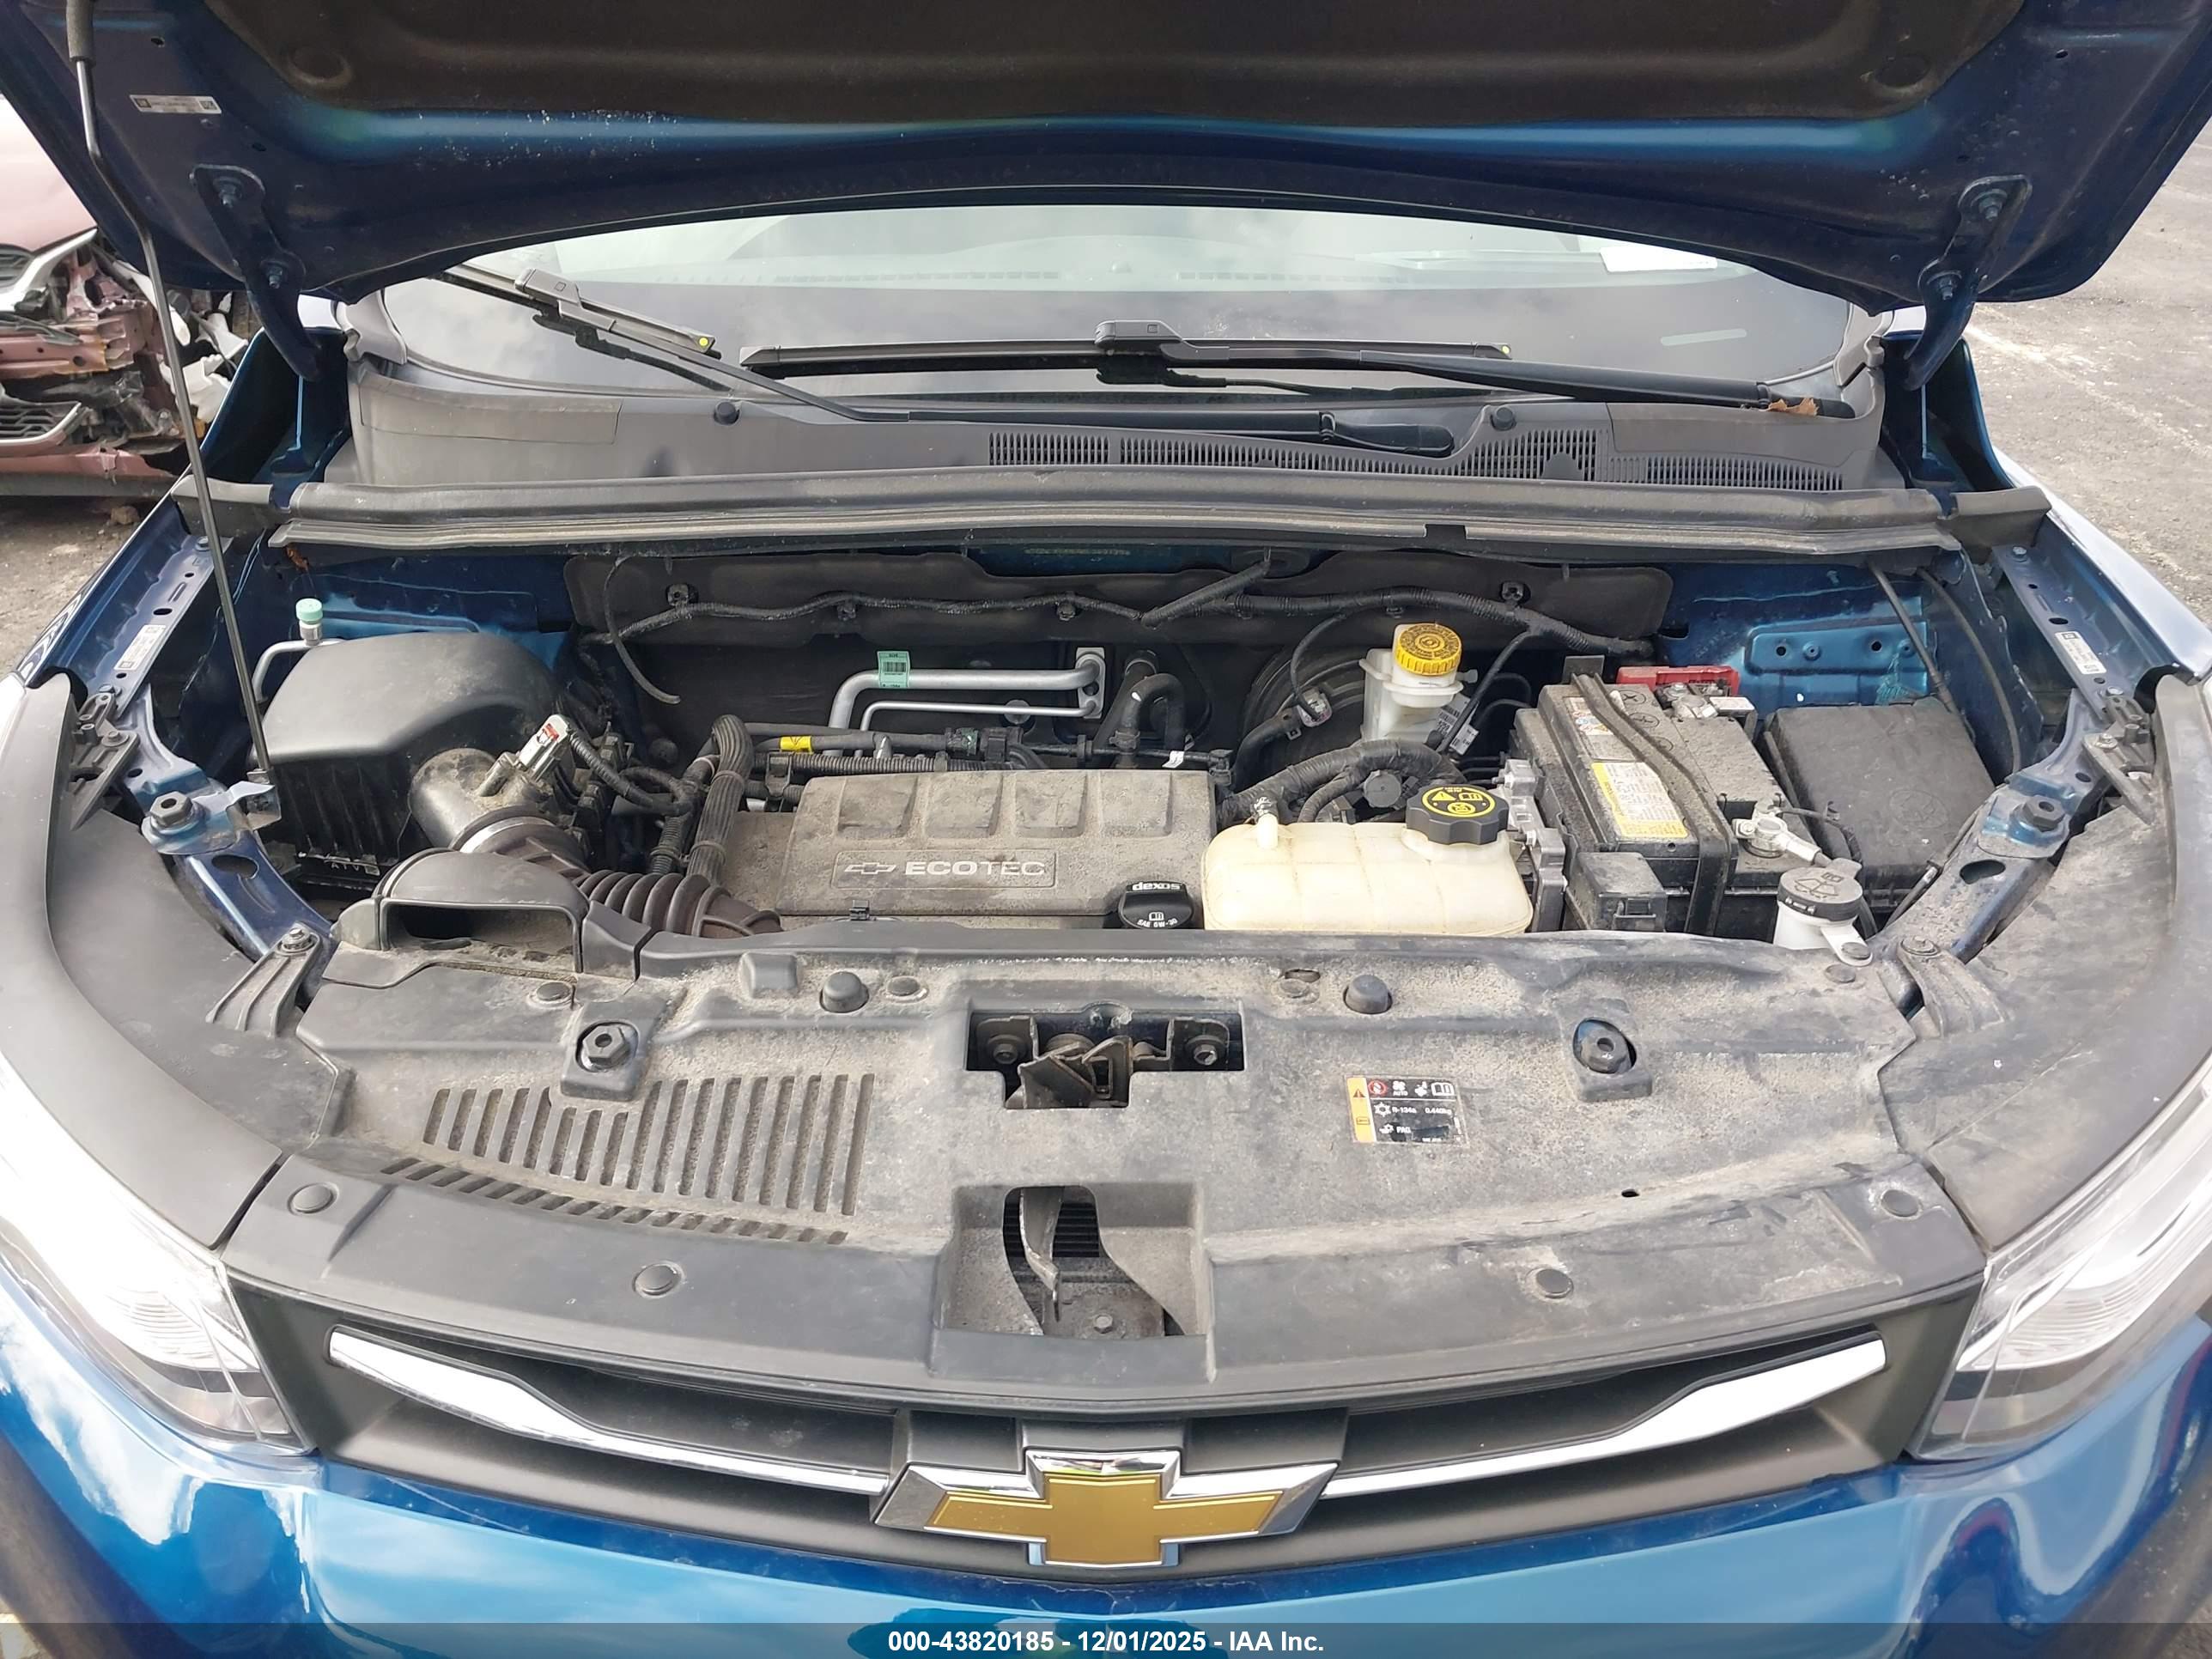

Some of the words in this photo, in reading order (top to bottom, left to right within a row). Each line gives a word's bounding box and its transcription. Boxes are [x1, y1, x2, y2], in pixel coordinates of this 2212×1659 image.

[904, 860, 1045, 877] ECOTEC
[1132, 882, 1181, 891] dexos
[1137, 919, 1152, 927] SAE
